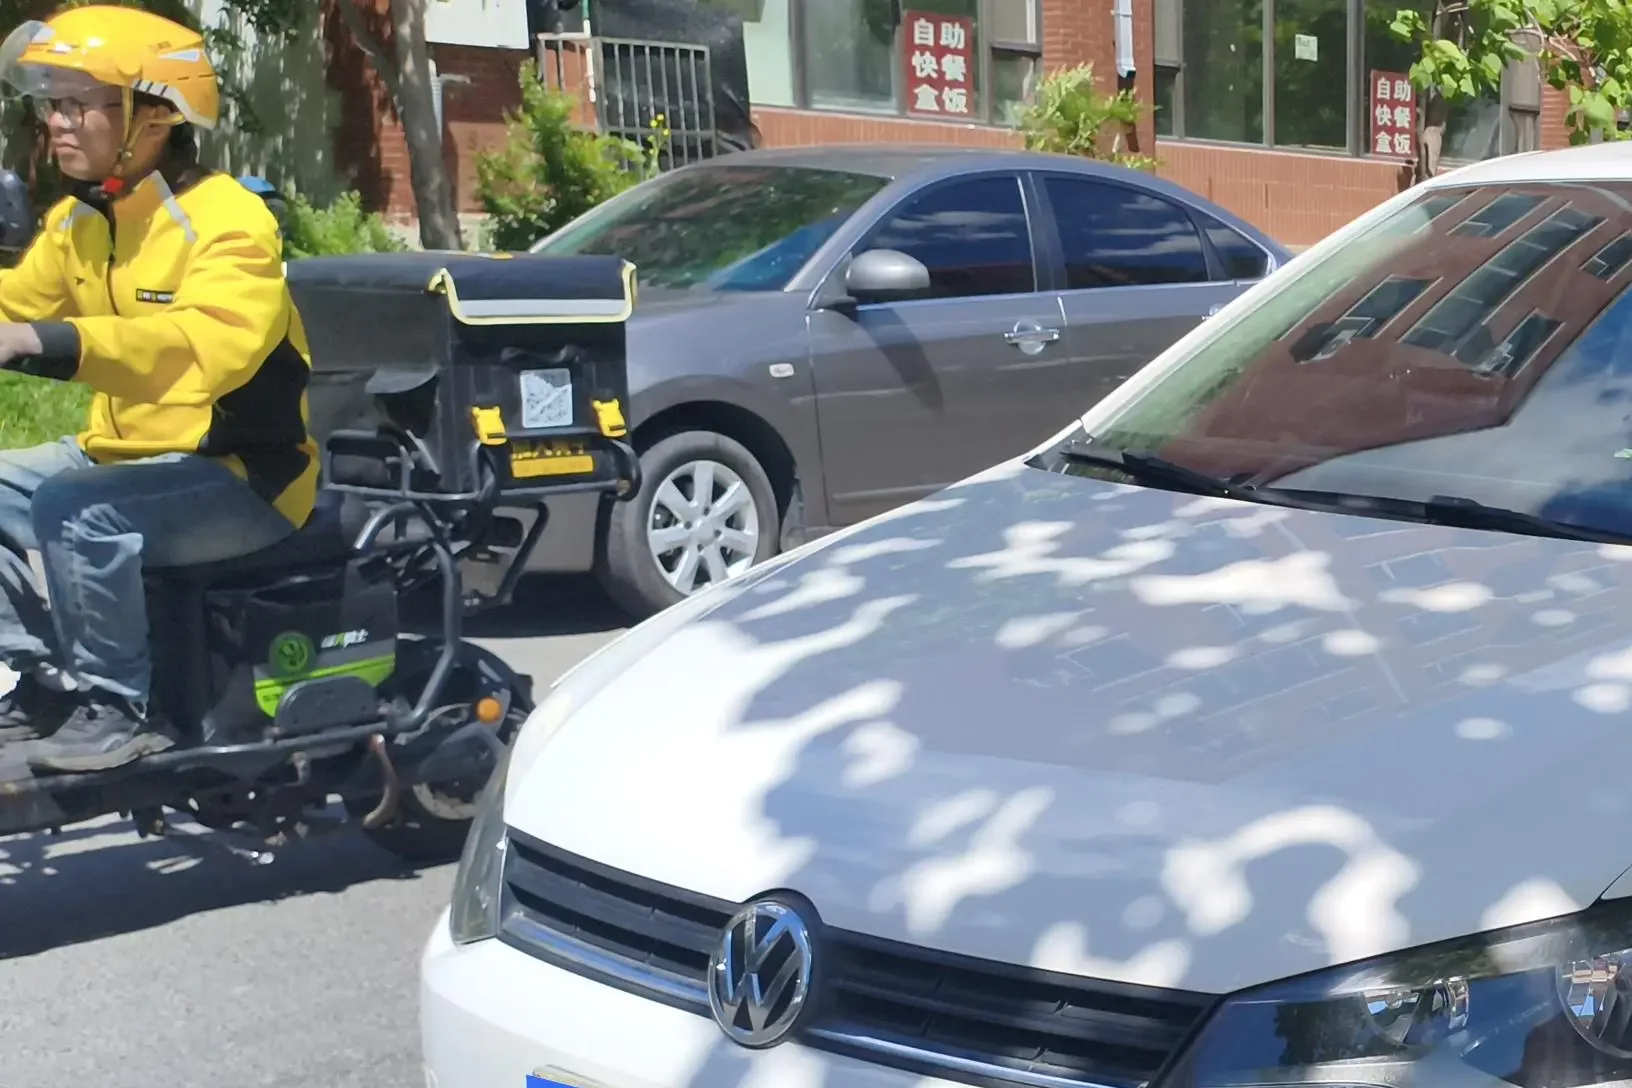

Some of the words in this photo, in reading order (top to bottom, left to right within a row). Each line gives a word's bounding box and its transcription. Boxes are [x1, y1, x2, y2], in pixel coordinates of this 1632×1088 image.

[913, 18, 965, 49] 自助
[912, 50, 966, 82] 快餐
[913, 83, 968, 113] 盒饭
[1377, 77, 1411, 102] 自助
[1375, 103, 1411, 129] 快餐
